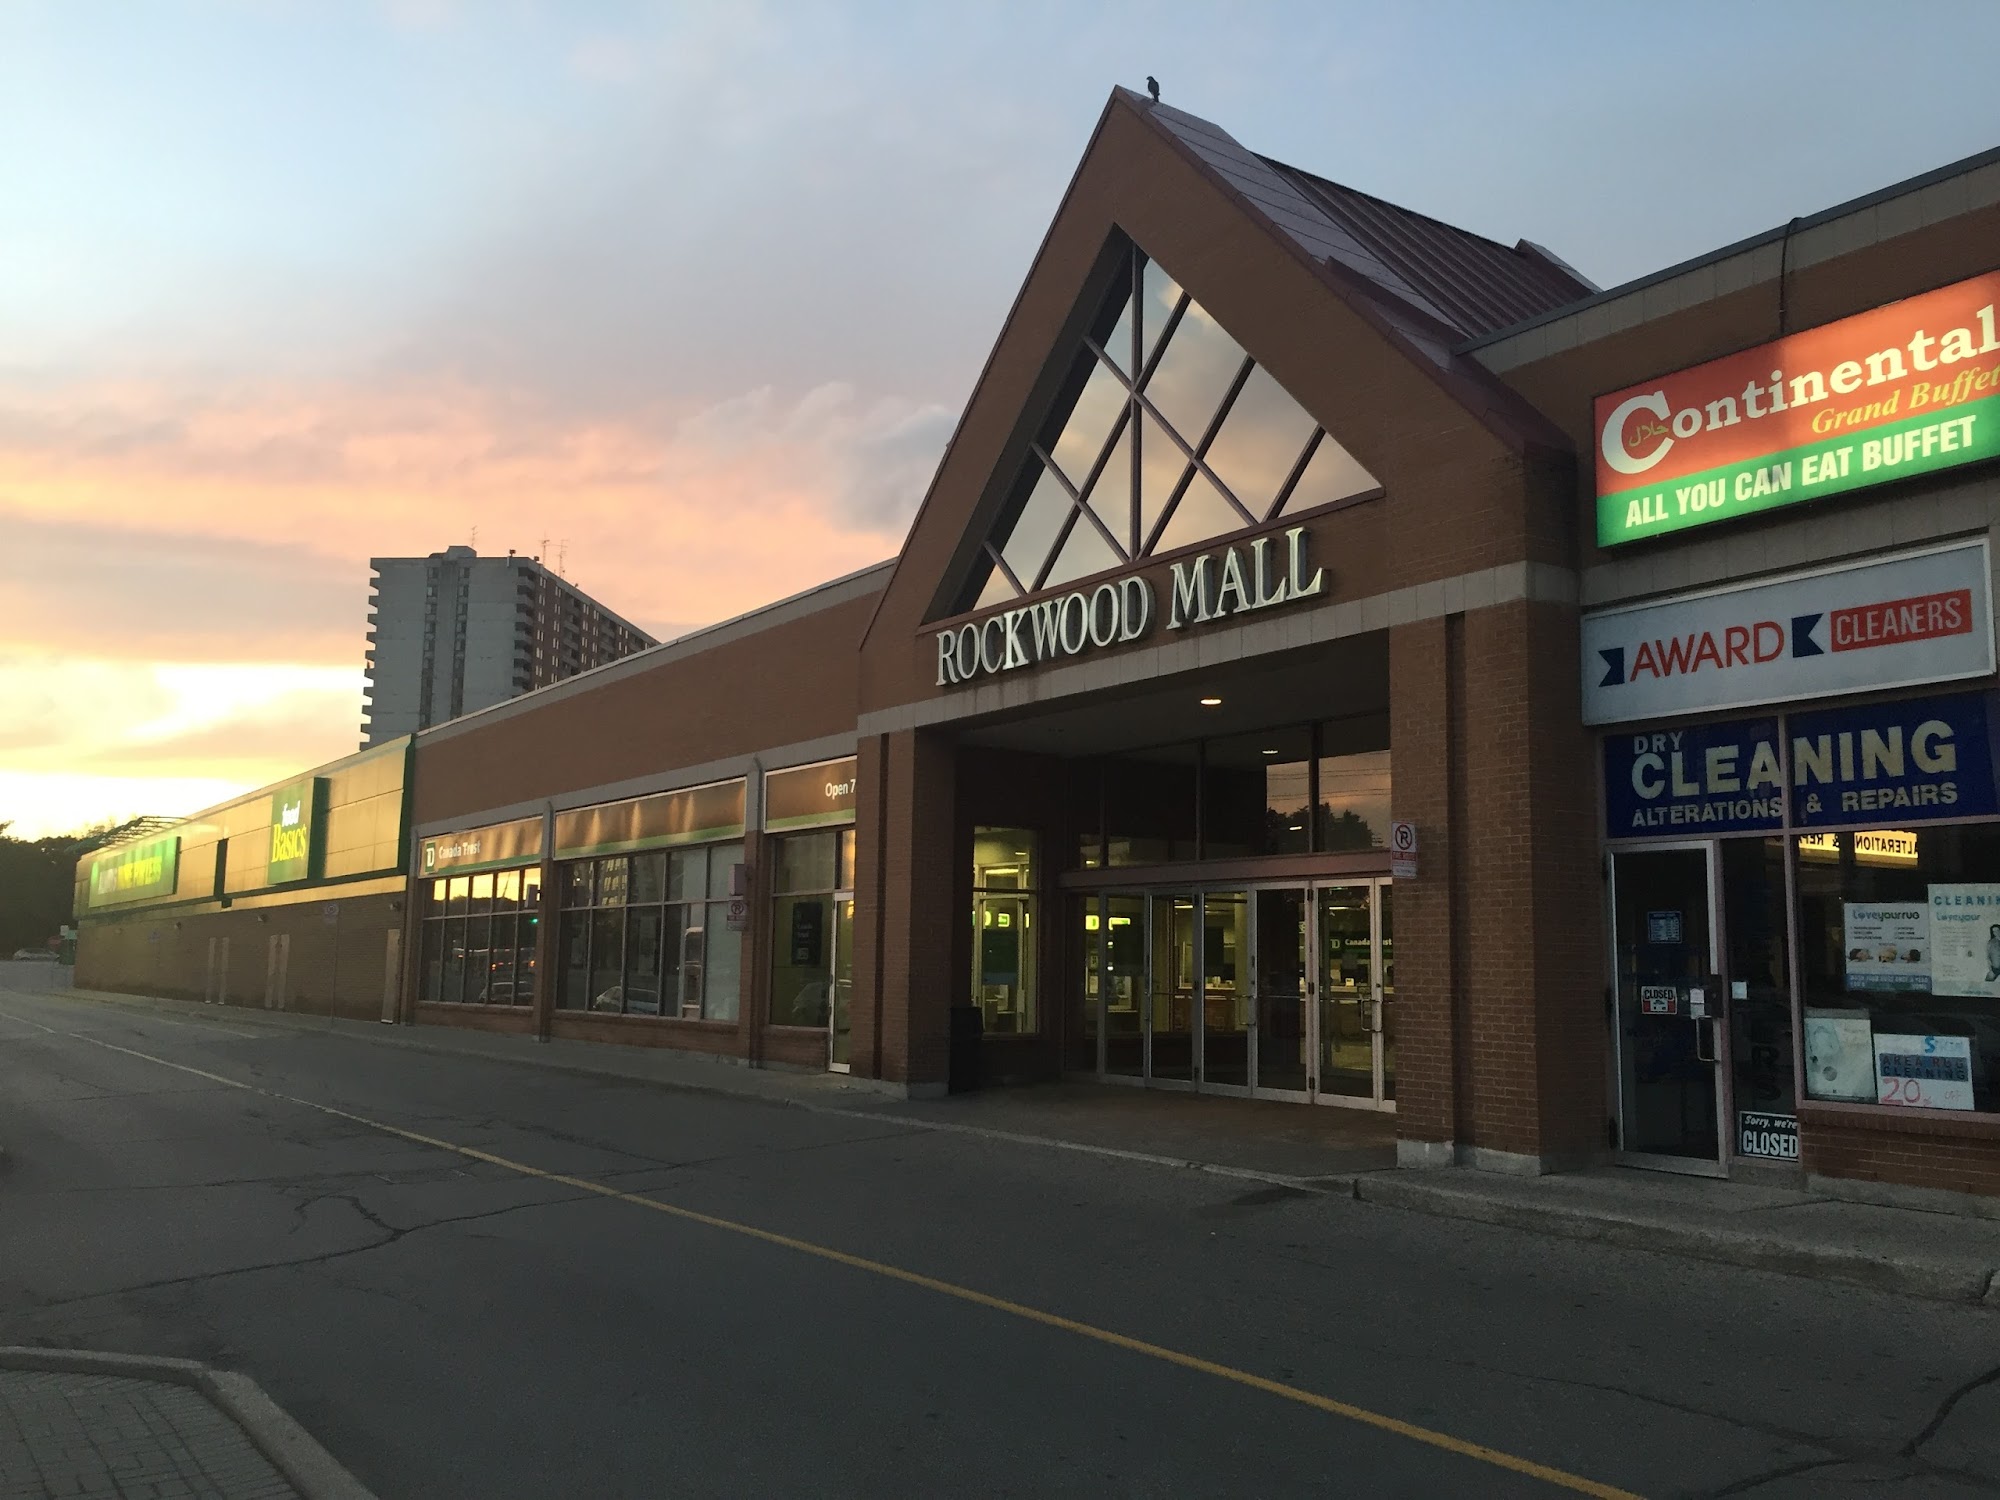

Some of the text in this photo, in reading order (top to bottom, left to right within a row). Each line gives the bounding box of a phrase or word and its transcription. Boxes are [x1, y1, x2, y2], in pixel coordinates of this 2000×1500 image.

[1602, 304, 2000, 475] Continental
[1812, 393, 1899, 434] Grand
[1625, 415, 1976, 528] ALL YOU CAN EAT BUFFET
[936, 526, 1327, 687] ROCKWOOD MALL
[1630, 598, 1962, 682] AWARD CLEANERS
[1631, 720, 1957, 800] CLEANING
[1634, 732, 1683, 755] DRY
[825, 778, 856, 800] Open 7
[1632, 782, 1958, 828] ALTERATIONS & REPAIRS
[438, 843, 462, 860] Canada
[463, 840, 481, 856] Trust
[1644, 988, 1674, 1001] CLOSED
[1742, 1129, 1799, 1158] CLOSED
